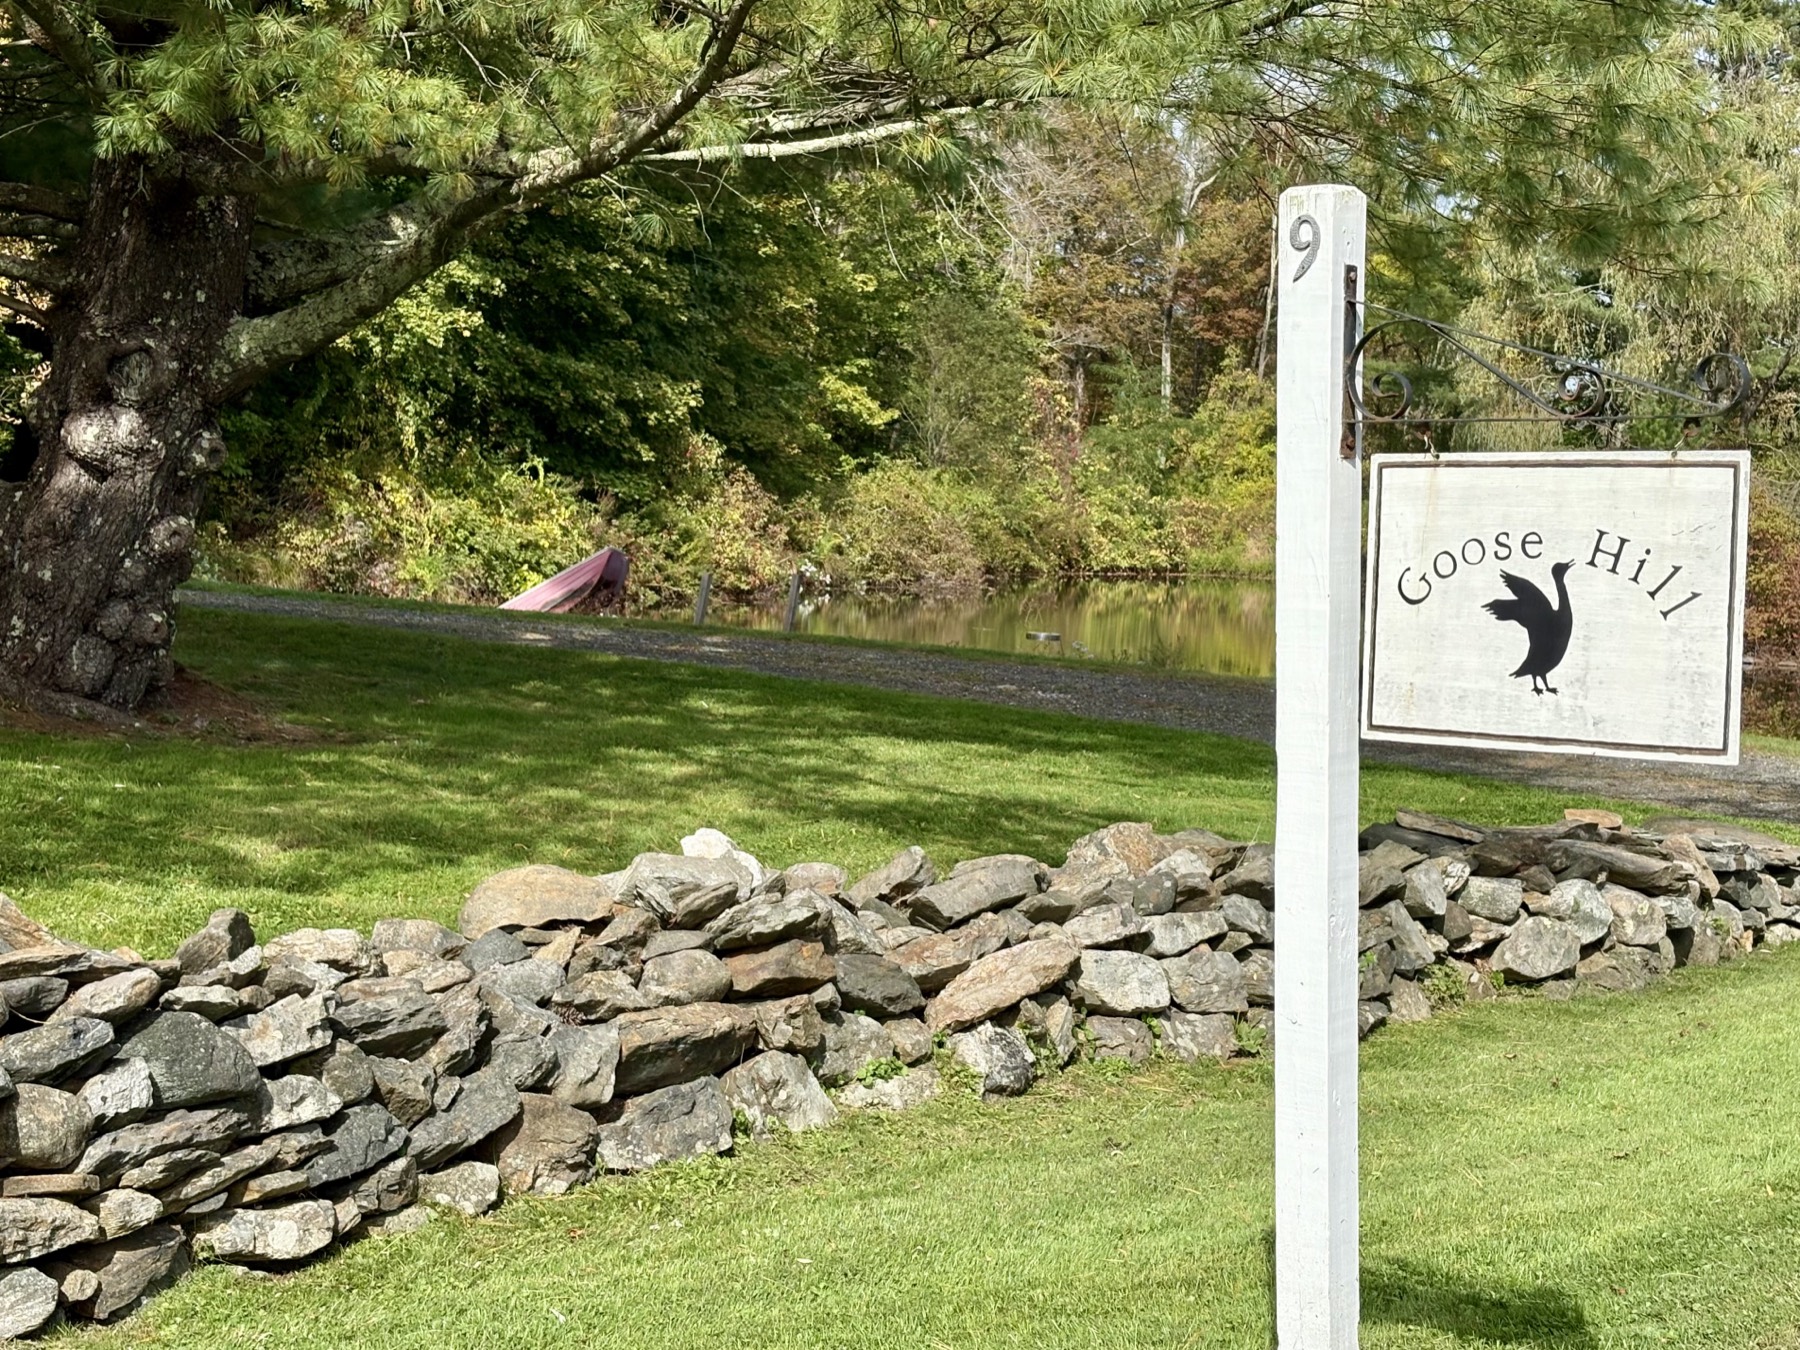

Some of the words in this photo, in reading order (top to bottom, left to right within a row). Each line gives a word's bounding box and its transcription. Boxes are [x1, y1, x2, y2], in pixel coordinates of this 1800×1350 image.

[1290, 214, 1320, 283] 9
[1397, 531, 1544, 605] Goose
[1585, 528, 1703, 621] Hill
